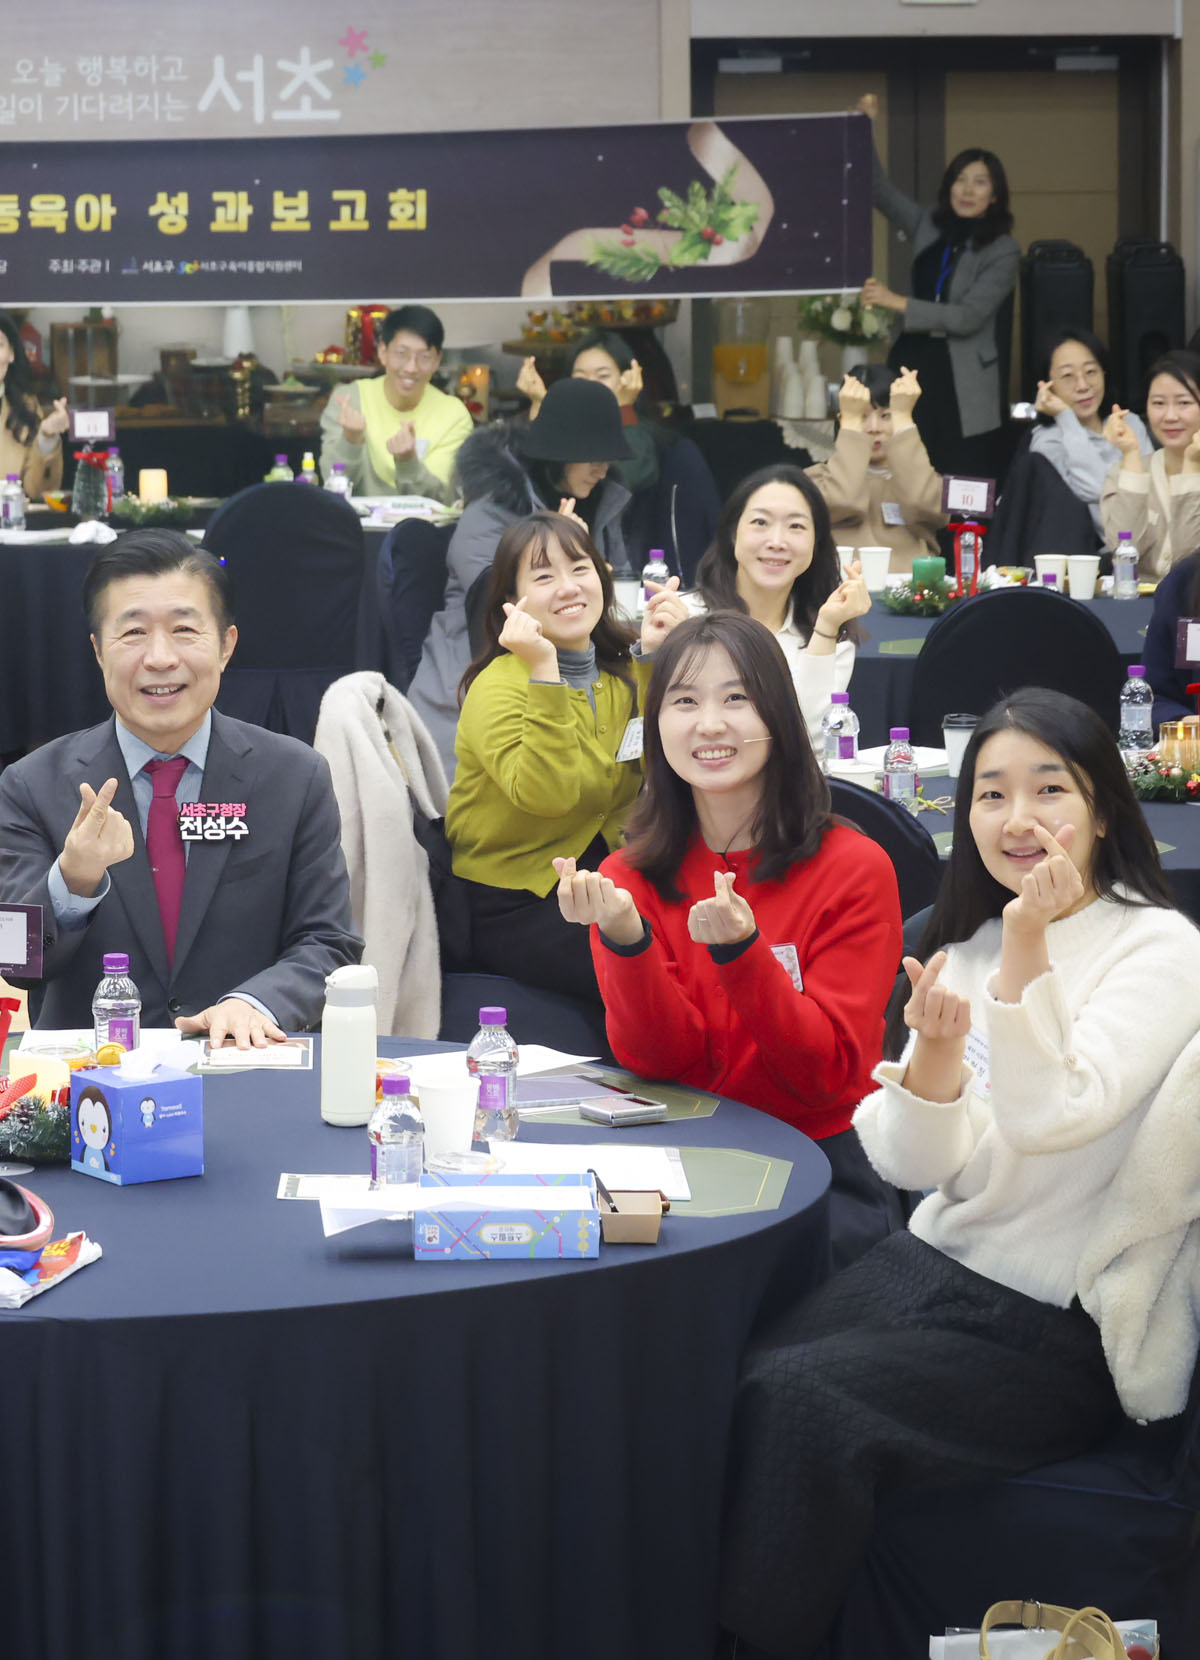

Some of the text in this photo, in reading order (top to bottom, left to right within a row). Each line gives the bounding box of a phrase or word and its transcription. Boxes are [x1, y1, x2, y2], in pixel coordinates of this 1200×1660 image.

[10, 55, 189, 87] 오늘 행복하고
[197, 45, 341, 124] 서초
[55, 91, 189, 124] 기다려지는
[180, 802, 247, 817] 서초구청장
[179, 816, 249, 840] 전성수
